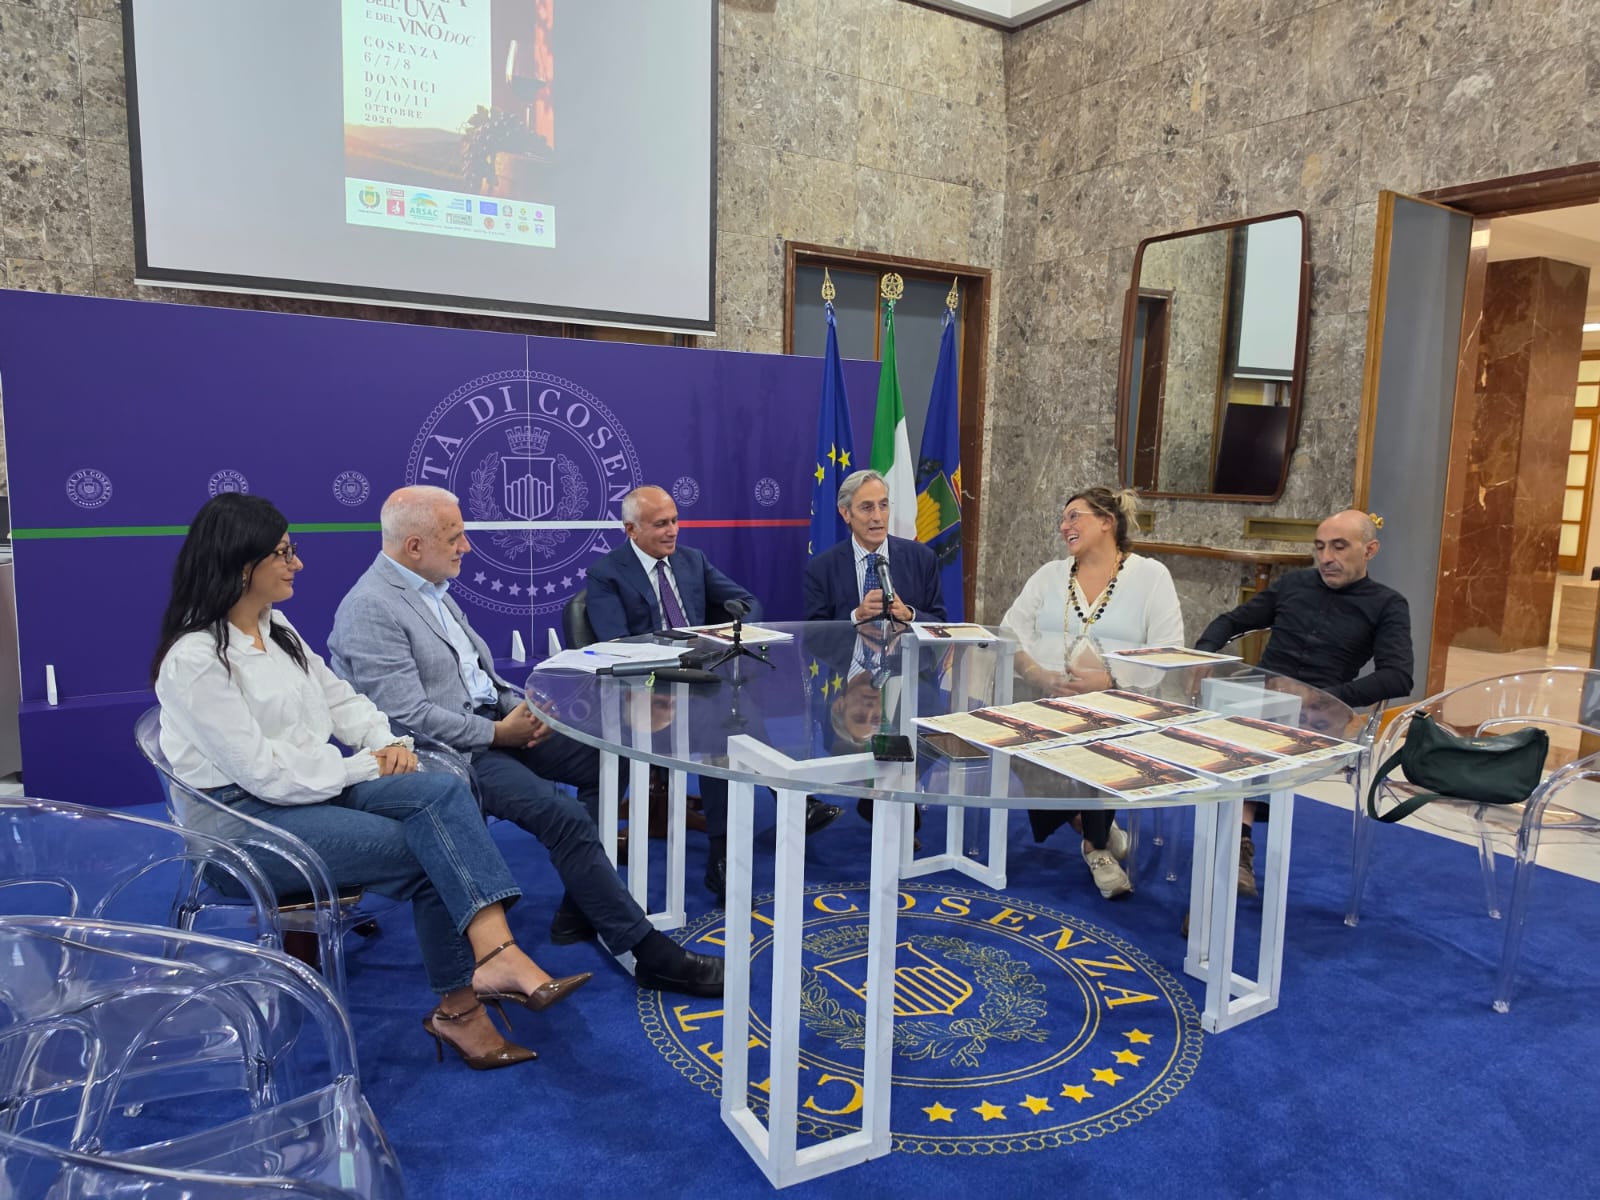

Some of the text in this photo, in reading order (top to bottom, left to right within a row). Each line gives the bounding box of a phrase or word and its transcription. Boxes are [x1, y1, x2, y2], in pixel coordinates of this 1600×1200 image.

[366, 10, 476, 47] E DEL VINO DOC
[363, 35, 439, 60] COSENZA
[364, 51, 411, 70] 6/7/8
[364, 70, 436, 94] DONNICI
[364, 86, 428, 108] 9/10/11
[364, 102, 423, 119] OTTOBRE
[409, 207, 439, 217] ARSAC
[465, 385, 517, 425] DI
